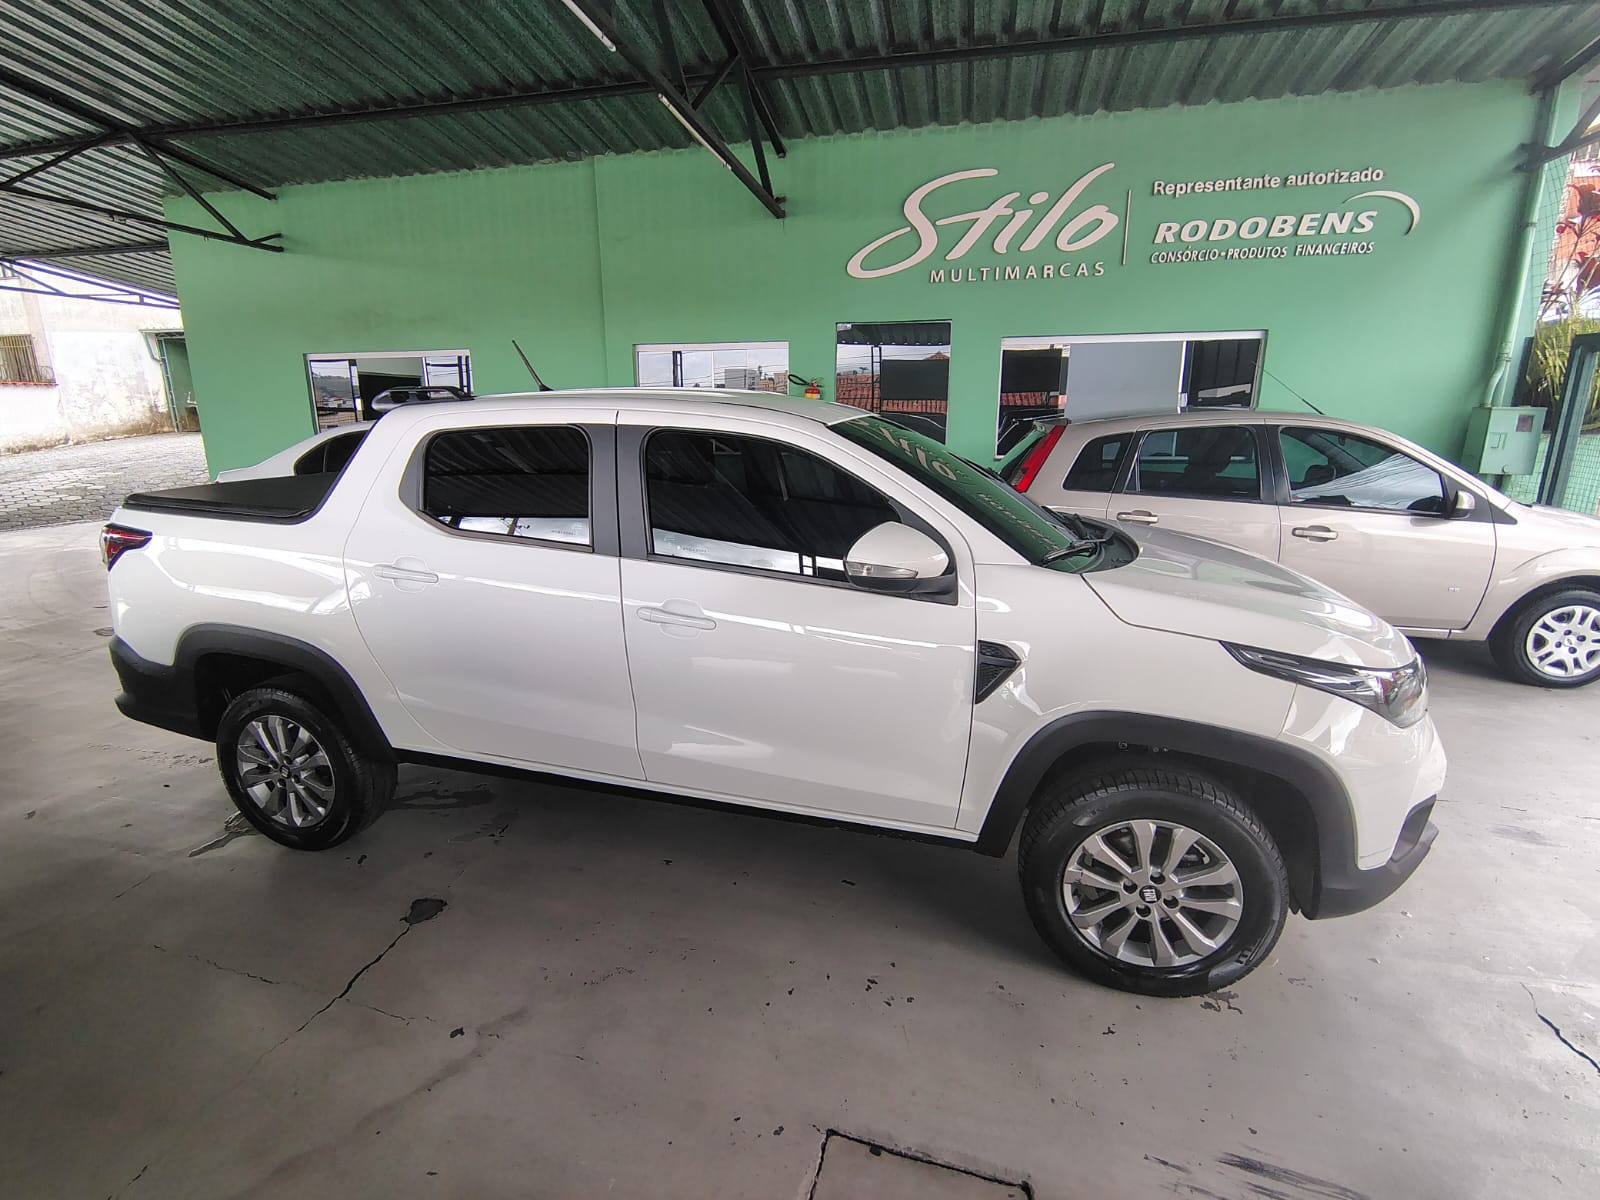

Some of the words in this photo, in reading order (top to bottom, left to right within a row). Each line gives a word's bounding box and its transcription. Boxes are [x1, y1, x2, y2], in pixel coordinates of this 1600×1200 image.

[1153, 173, 1281, 198] Representante
[1286, 167, 1385, 188] autorizado
[846, 162, 1119, 279] Stilo
[1153, 211, 1378, 244] RODOBENS
[1295, 242, 1375, 257] FINANCEIROS
[930, 262, 1105, 283] MULTIMARCAS
